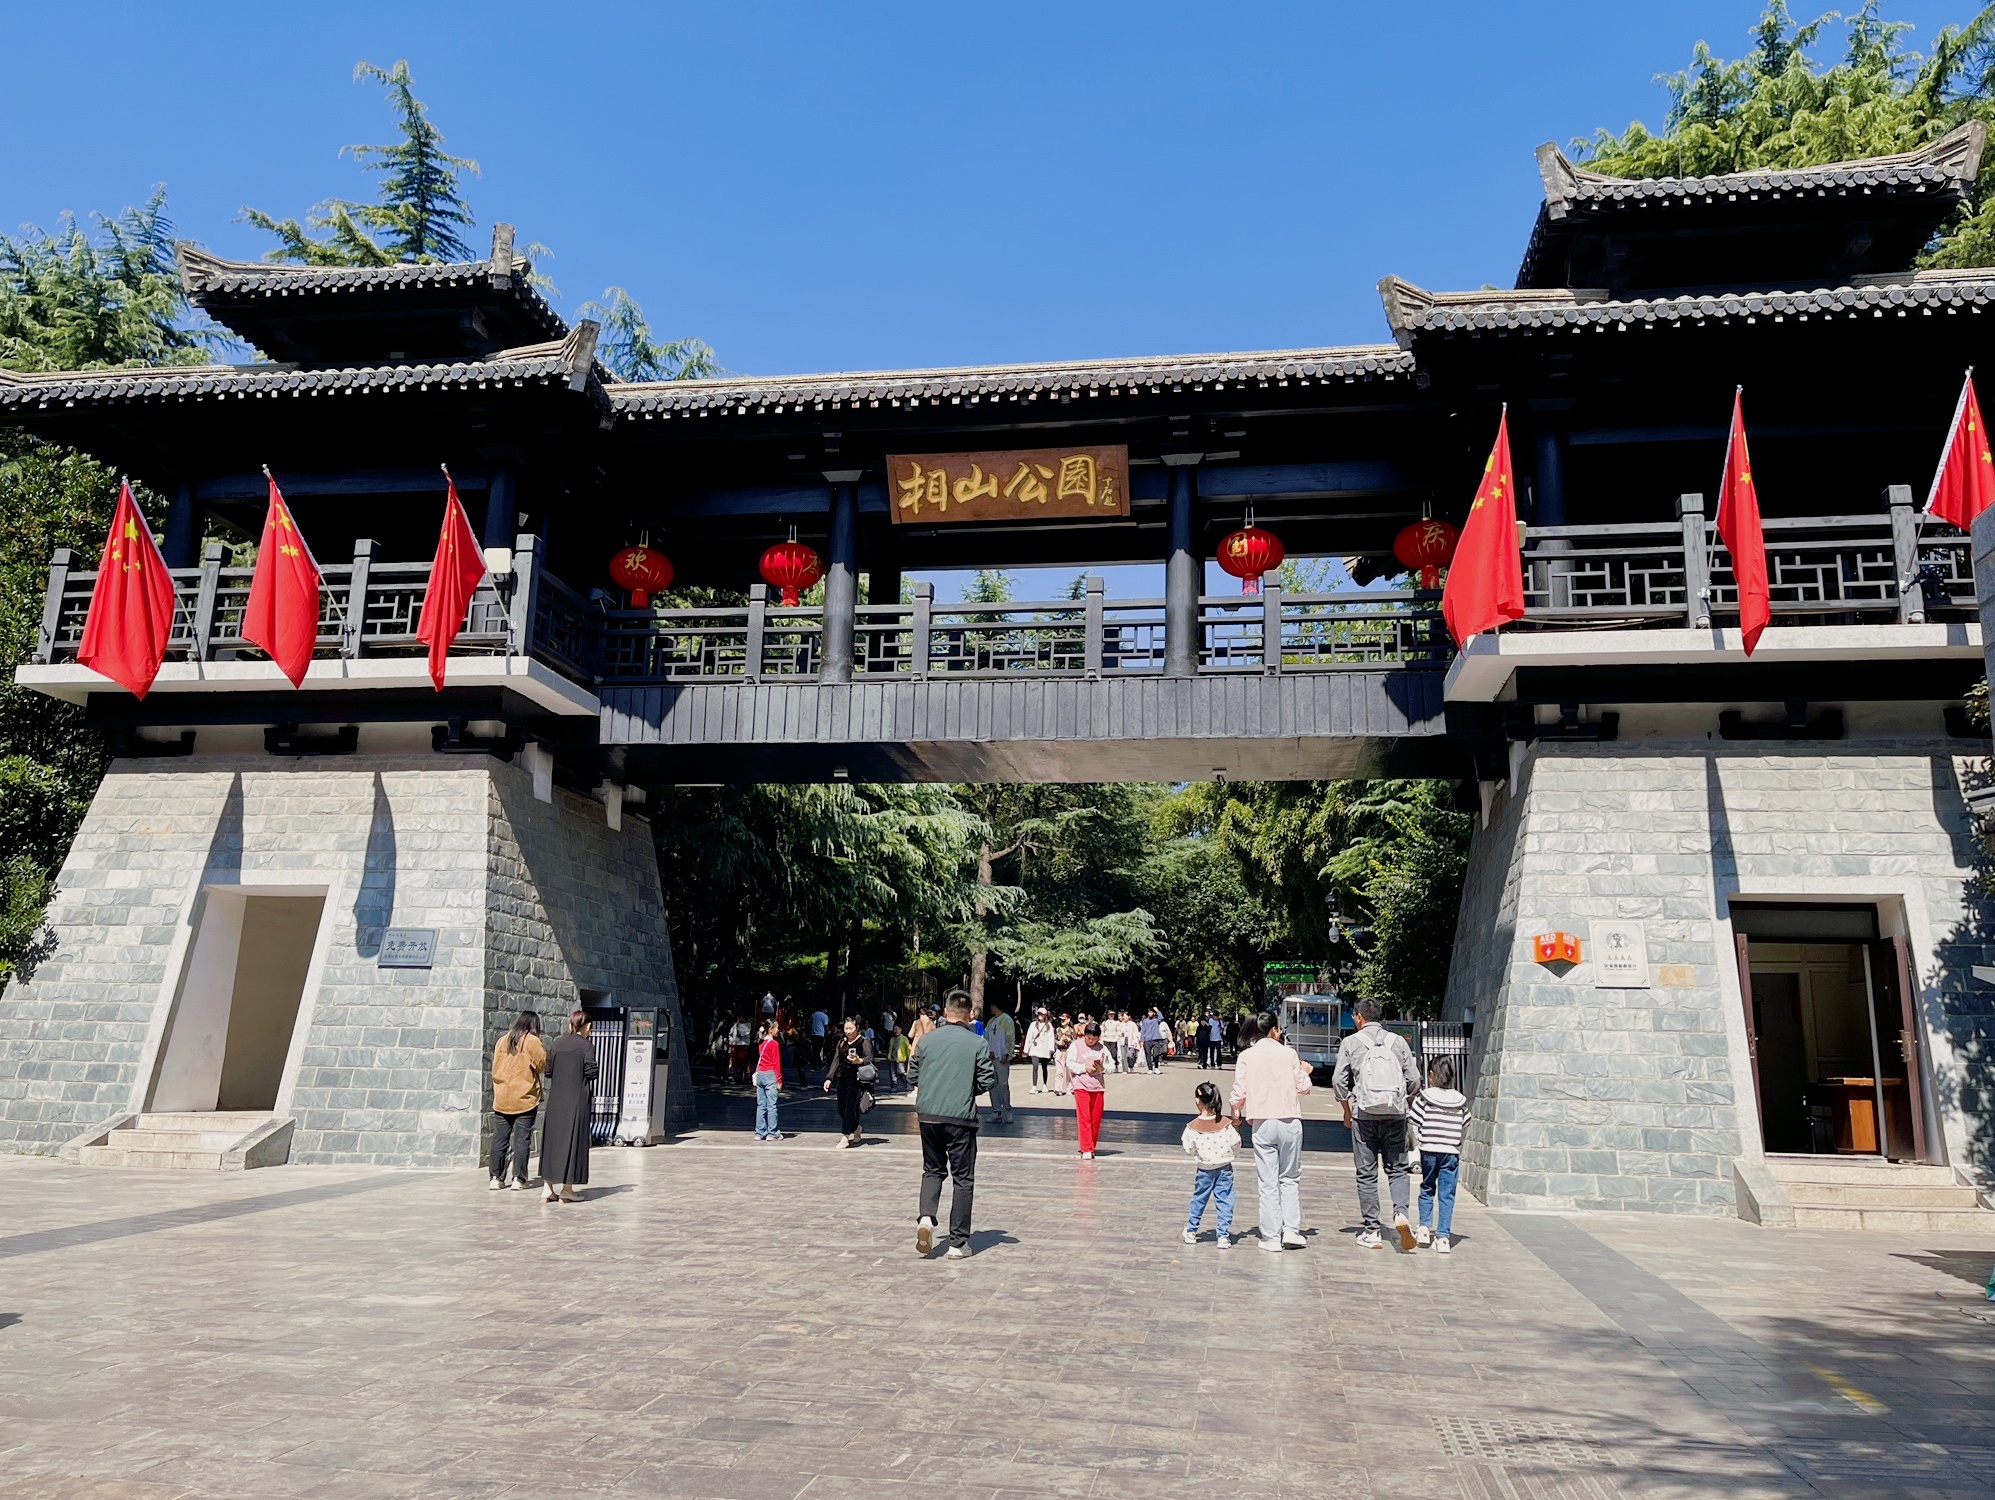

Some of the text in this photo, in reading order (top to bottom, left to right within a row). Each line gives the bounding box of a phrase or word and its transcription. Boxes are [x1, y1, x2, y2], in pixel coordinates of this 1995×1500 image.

[1422, 521, 1447, 547] 庆
[625, 549, 650, 574] 欢
[1539, 933, 1556, 942] AED
[1562, 932, 1575, 944] AED
[386, 940, 428, 951] 免费开放
